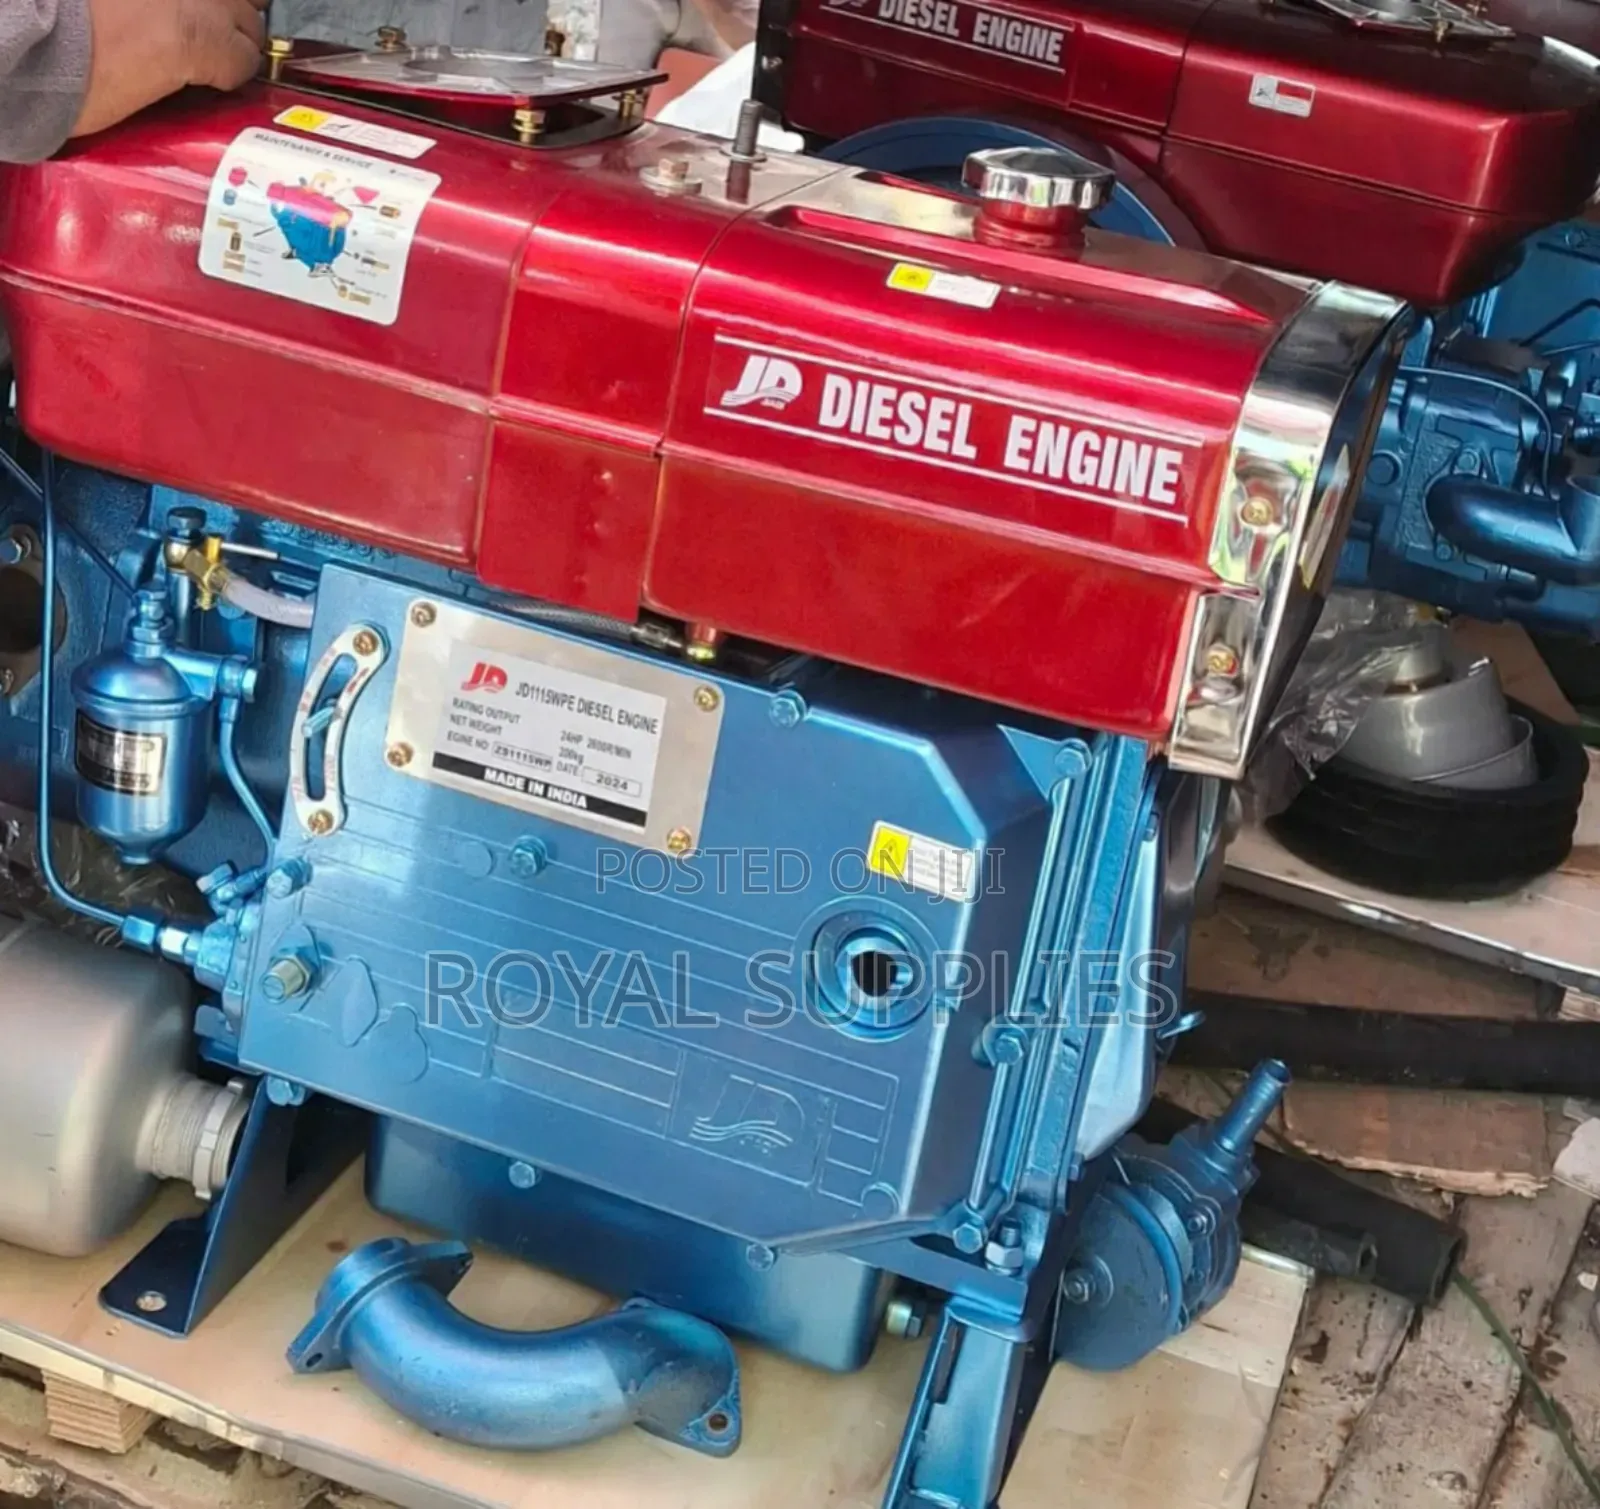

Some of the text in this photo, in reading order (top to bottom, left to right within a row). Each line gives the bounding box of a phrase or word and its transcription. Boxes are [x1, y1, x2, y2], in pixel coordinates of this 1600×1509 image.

[972, 12, 1064, 63] ENGINE
[818, 373, 977, 460] DIESEL
[1004, 415, 1183, 504] ENGINE
[461, 661, 508, 694] JD
[450, 713, 503, 736] NET WEIGHT
[452, 697, 521, 724] RATING OUTPUT
[577, 697, 615, 723] DIESEL
[617, 708, 659, 734] ENGINE
[483, 767, 588, 809] MADE IN INDIA
[596, 773, 629, 791] 2024
